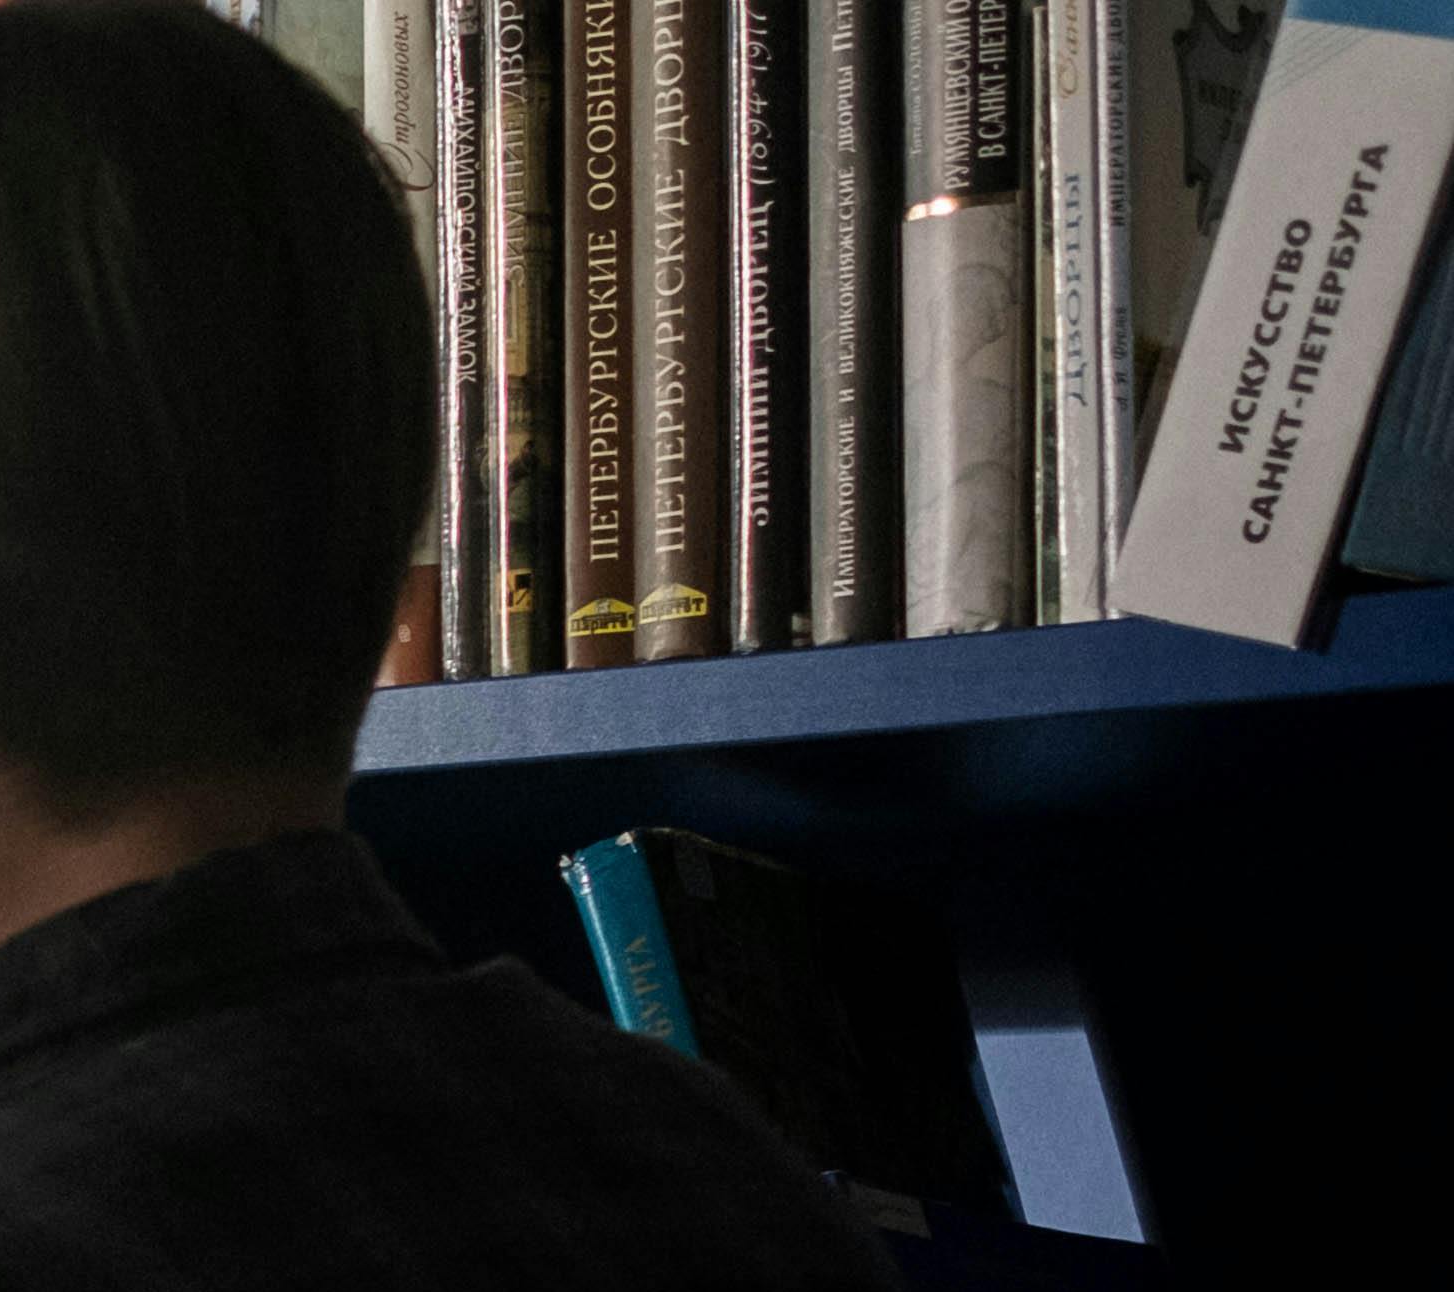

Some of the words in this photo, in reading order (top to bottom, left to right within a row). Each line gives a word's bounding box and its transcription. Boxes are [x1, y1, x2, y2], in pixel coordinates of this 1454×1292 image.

[937, 17, 975, 190] РУМЯНЦЕВСКИЙ
[978, 143, 1008, 158] В
[1106, 49, 1127, 228] ИМПЕРАТОРСКИЕ
[454, 299, 479, 384] ЗАМОК
[586, 229, 619, 561] ПЕТЕРБУРГСКИЕ
[653, 169, 686, 552] ПЕТЕРБУРГСКИЕ
[1059, 171, 1089, 408] ДВОРЦЫ
[1218, 219, 1313, 455] ИСКУССТВО
[1241, 143, 1390, 545] САНКТ-ПЕТЕРБУРГА
